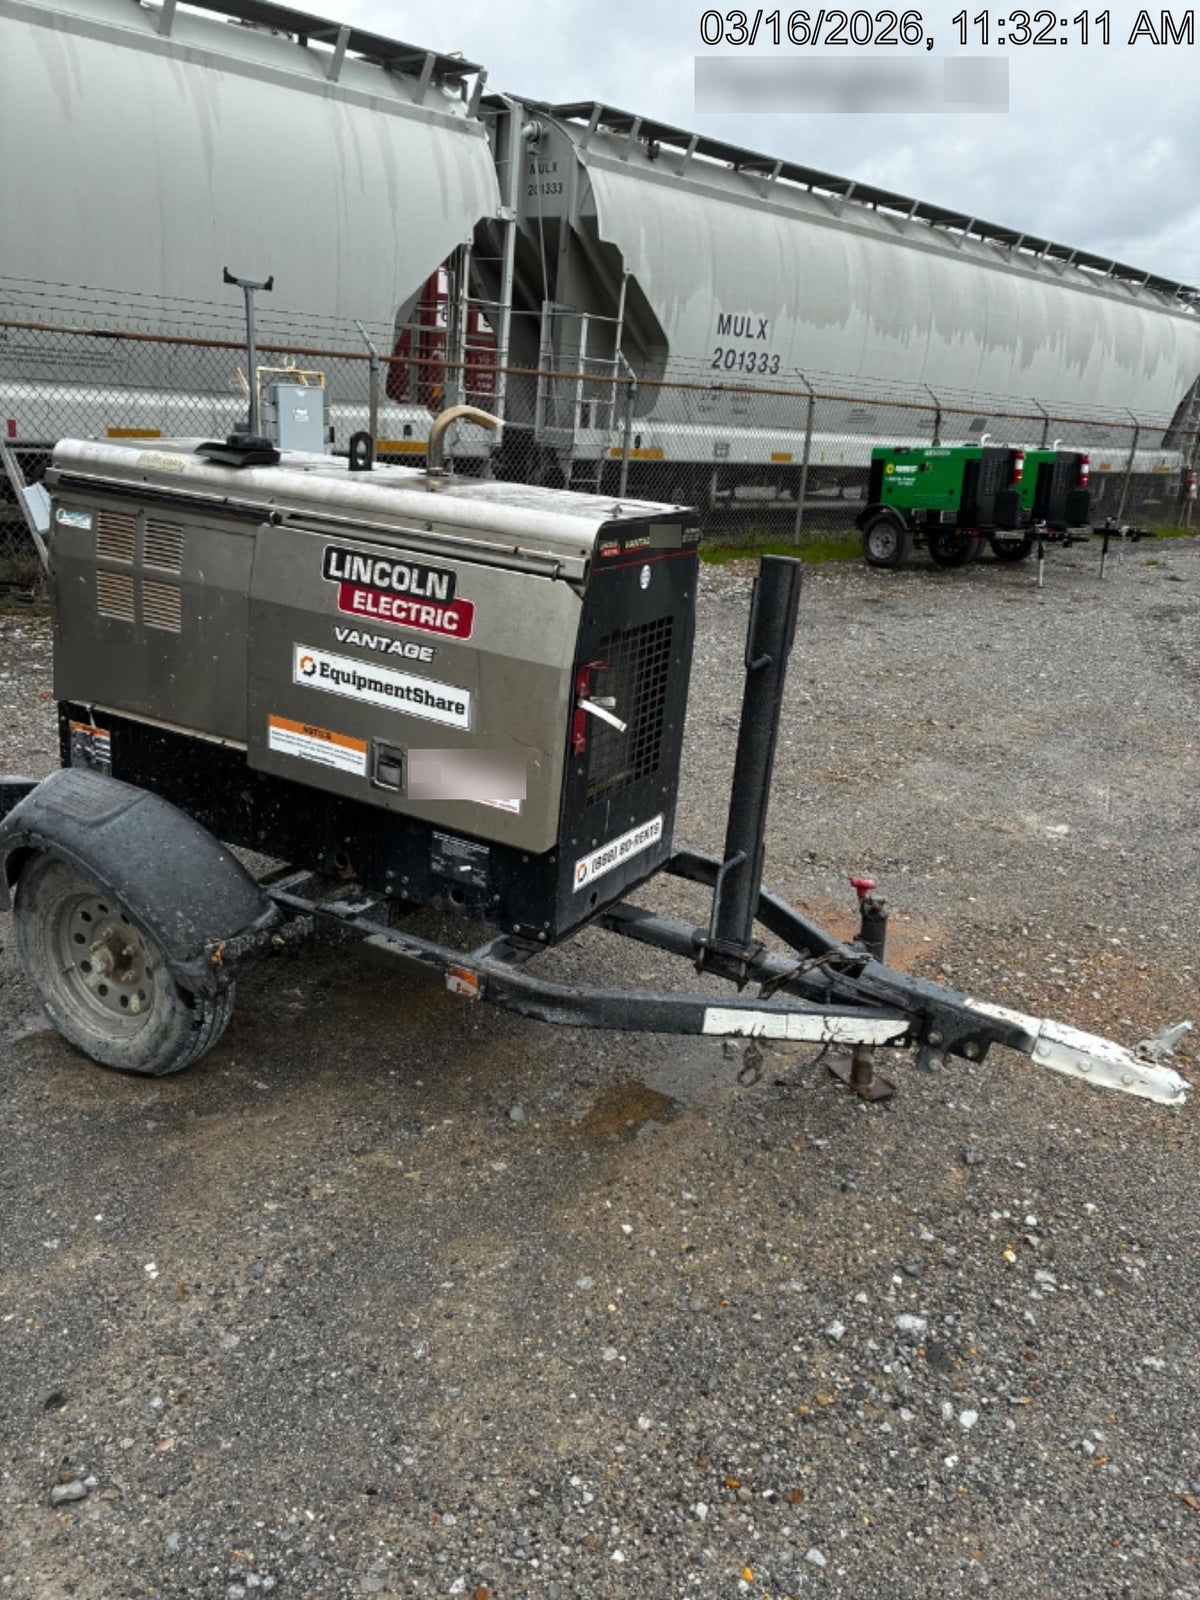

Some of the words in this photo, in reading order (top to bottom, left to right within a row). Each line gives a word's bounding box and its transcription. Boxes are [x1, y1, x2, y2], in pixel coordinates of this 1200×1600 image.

[716, 312, 769, 340] MULX
[710, 346, 782, 375] 201333
[328, 551, 450, 600] LINCOLN
[352, 589, 460, 631] ELECTRIC
[333, 625, 435, 663] VANTAGE
[319, 661, 466, 715] EquipmentShare
